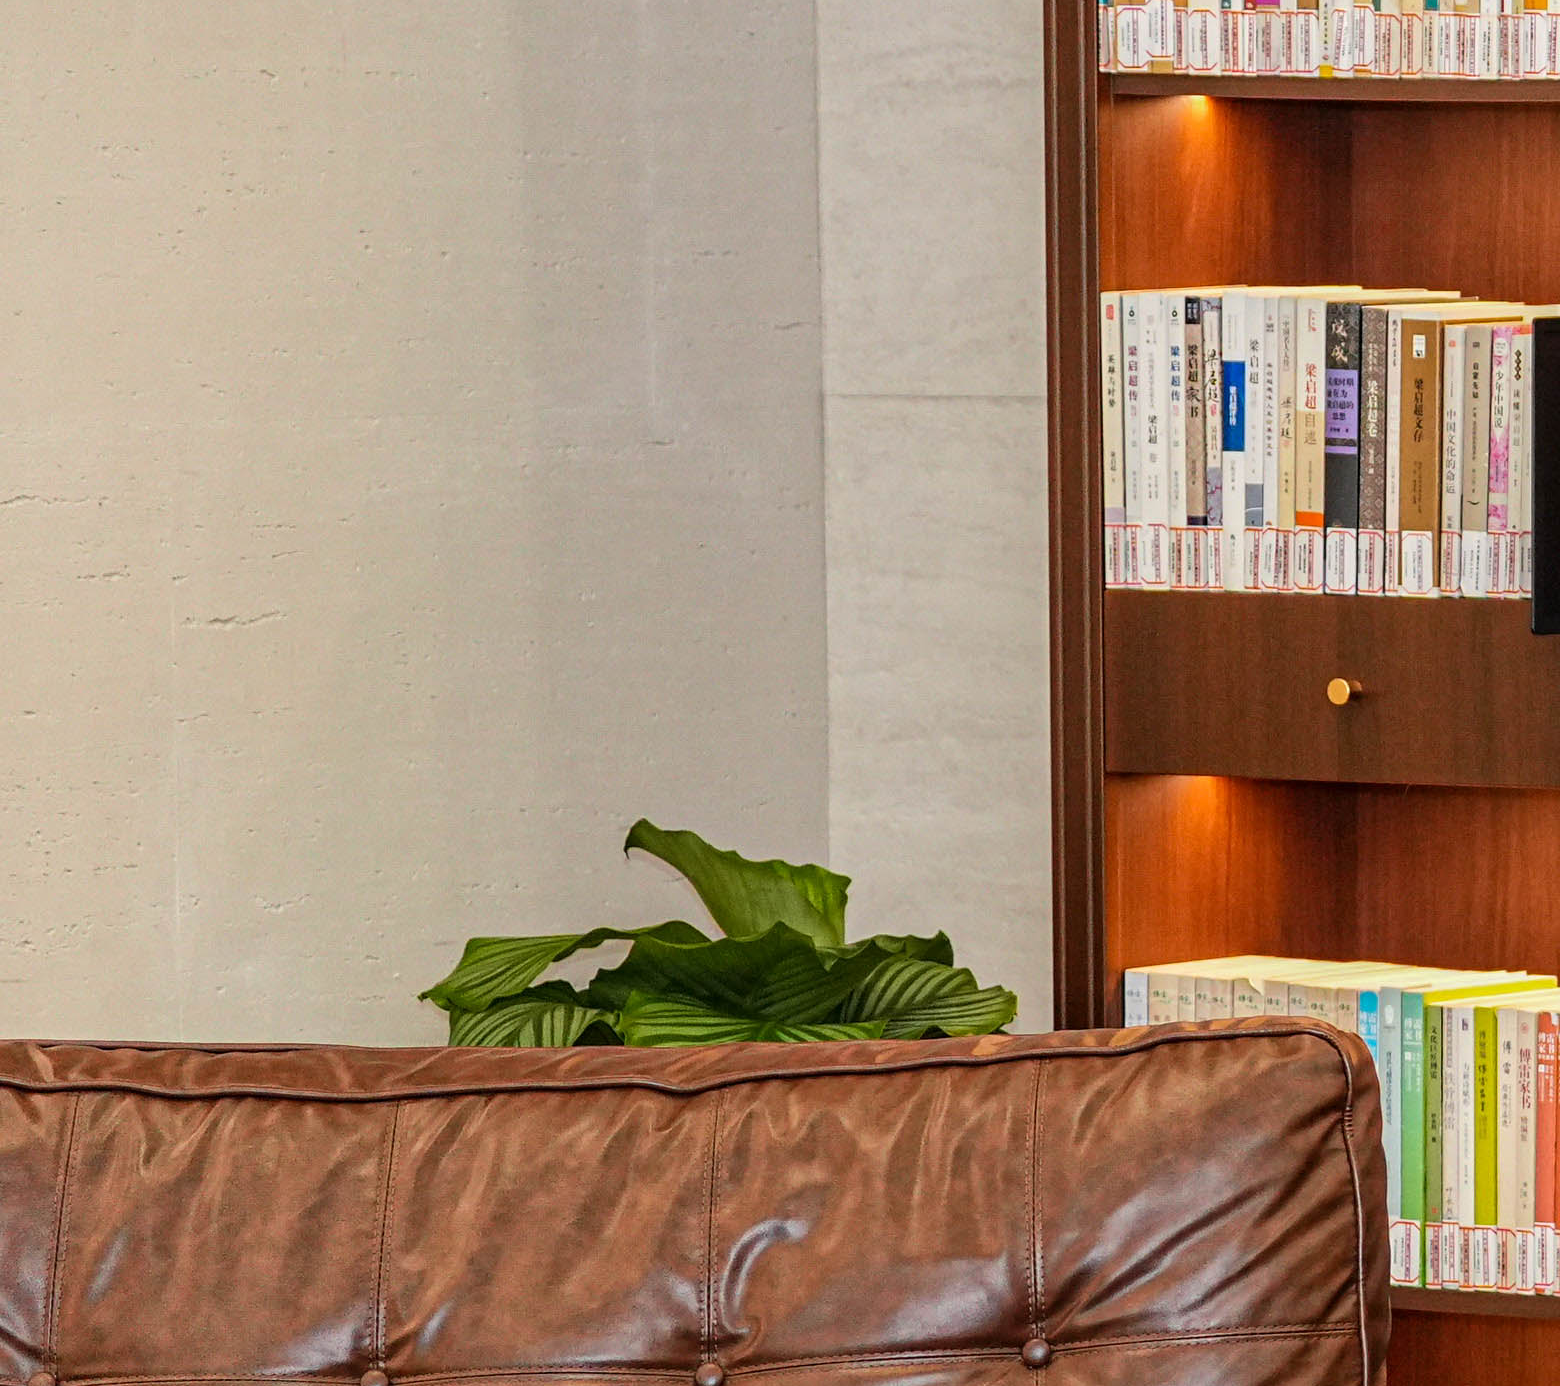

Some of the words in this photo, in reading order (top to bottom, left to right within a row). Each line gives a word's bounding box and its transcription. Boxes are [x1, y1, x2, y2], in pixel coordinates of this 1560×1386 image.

[1127, 344, 1139, 403] 梁启超传
[1169, 344, 1181, 403] 梁启超传
[1185, 343, 1201, 419] 梁启超家书
[1493, 369, 1505, 430] 少年中国说
[1445, 408, 1458, 495] 中国文化的命运
[1518, 1047, 1532, 1110] 傅雷家书
